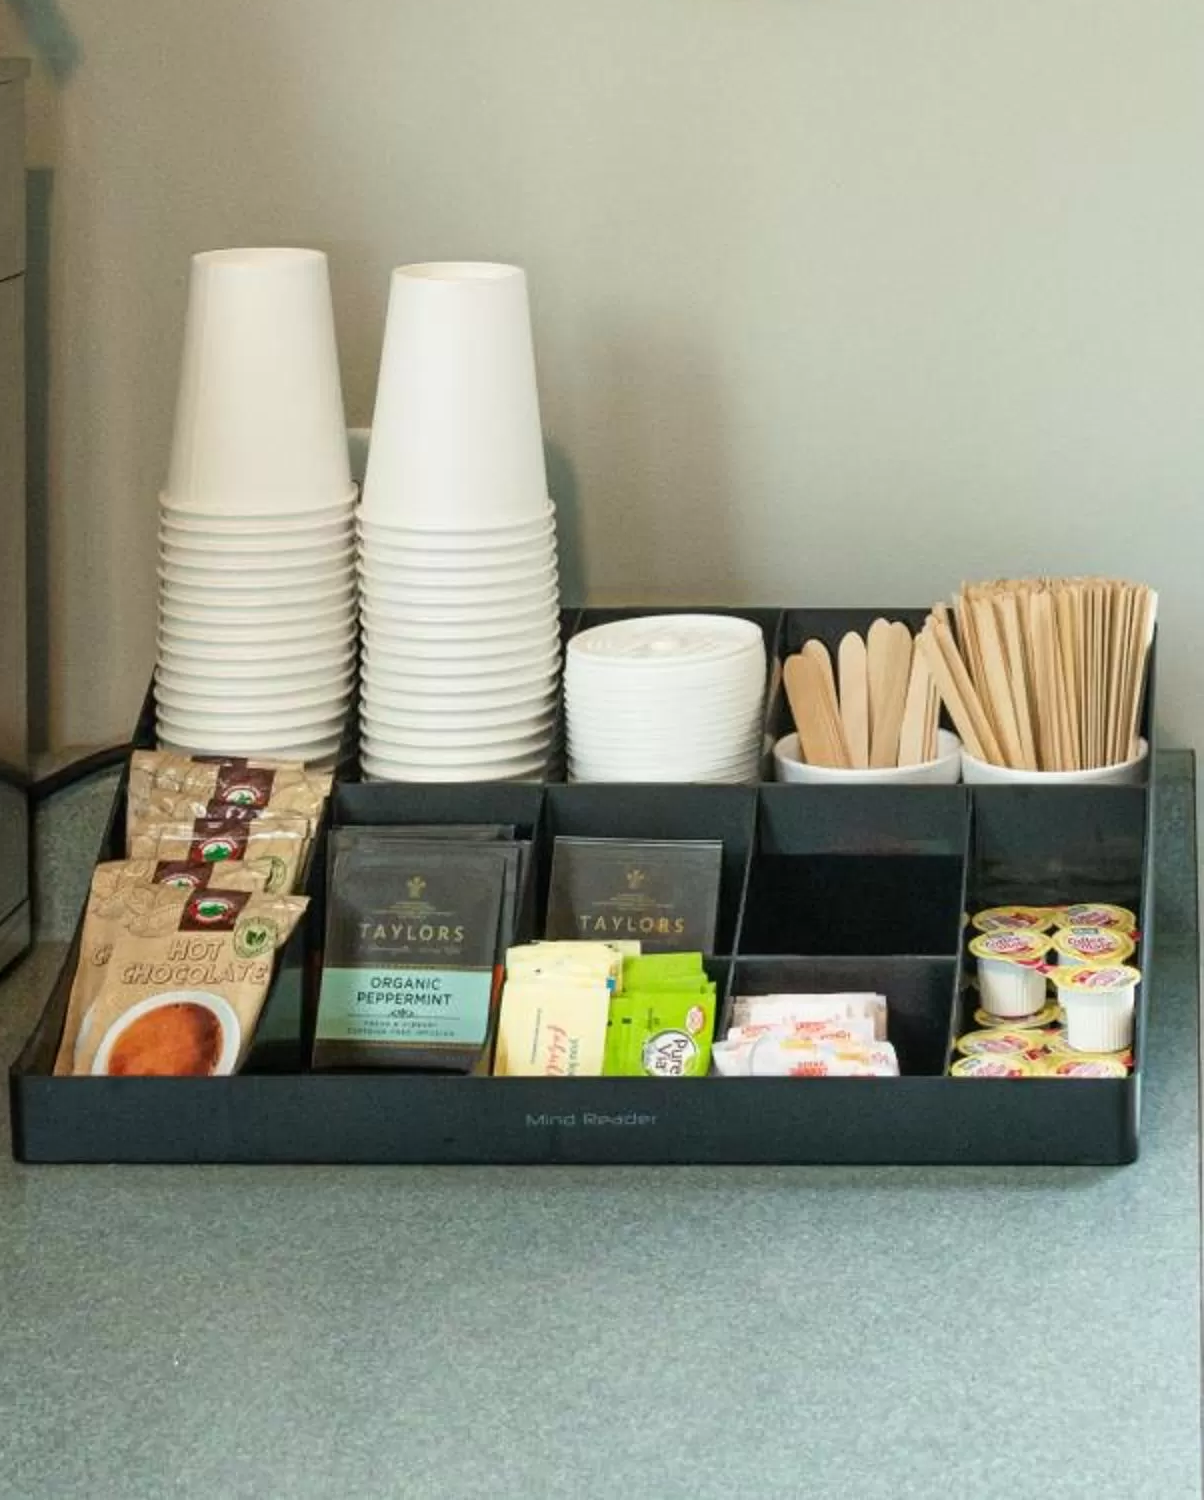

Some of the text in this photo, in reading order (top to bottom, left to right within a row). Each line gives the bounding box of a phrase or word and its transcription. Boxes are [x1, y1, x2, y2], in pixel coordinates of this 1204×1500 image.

[359, 923, 465, 943] TAYLORS
[579, 915, 684, 933] TAYLORS
[167, 937, 224, 961] HOT
[120, 961, 269, 985] CHOCOLATE
[370, 976, 442, 990] ORGANIC
[356, 991, 453, 1005] PEPPERMINT
[655, 1043, 673, 1070] Via
[669, 1039, 689, 1076] Pure
[525, 1112, 659, 1127] Mind Reader
